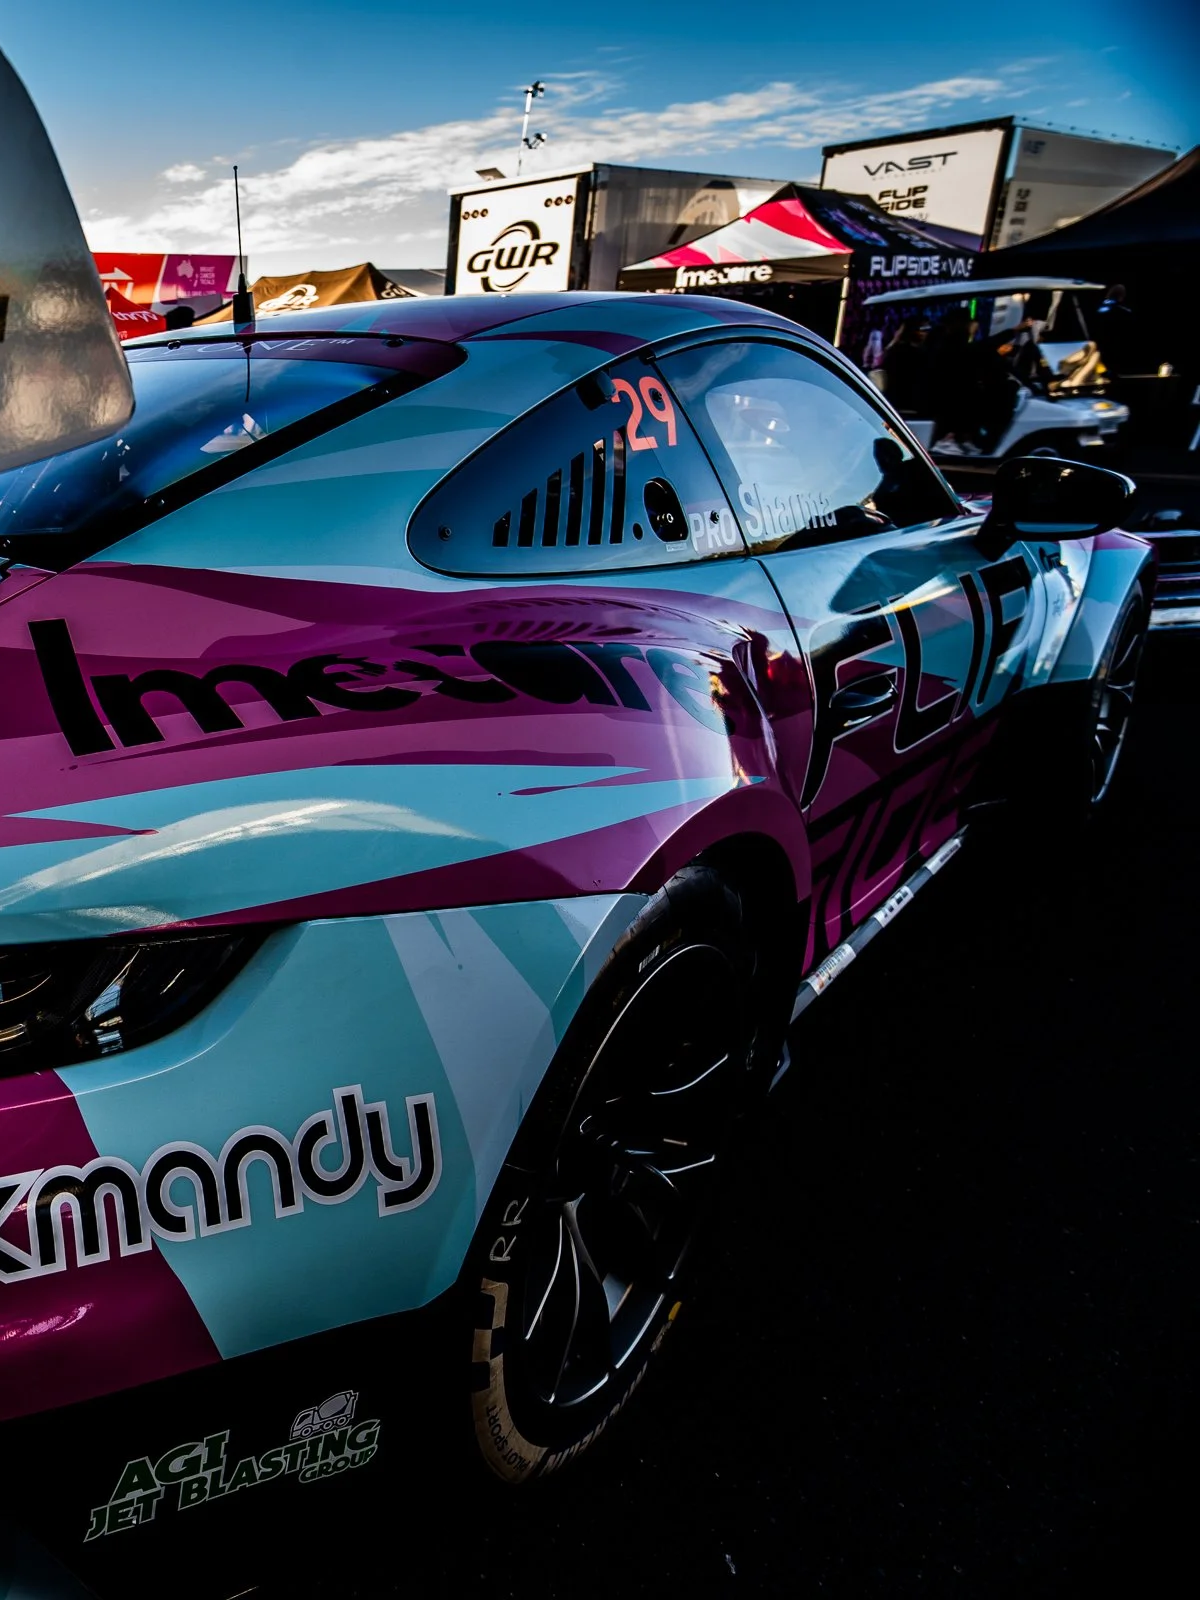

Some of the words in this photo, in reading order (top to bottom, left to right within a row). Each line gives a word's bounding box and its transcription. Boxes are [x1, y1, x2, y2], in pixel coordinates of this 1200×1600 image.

[863, 150, 958, 177] VAST
[878, 185, 929, 201] FLIP
[879, 197, 926, 212] SIDE
[467, 242, 560, 273] GWR
[869, 254, 941, 278] FLIPSIDE
[611, 376, 678, 452] 29
[689, 507, 737, 552] PRO
[800, 554, 1034, 813] FLIP
[485, 1405, 509, 1452] SPORT
[83, 1485, 166, 1543] JET
[177, 1418, 382, 1512] BLASTING
[108, 1429, 230, 1502] AGI
[298, 1444, 379, 1484] GROUP
